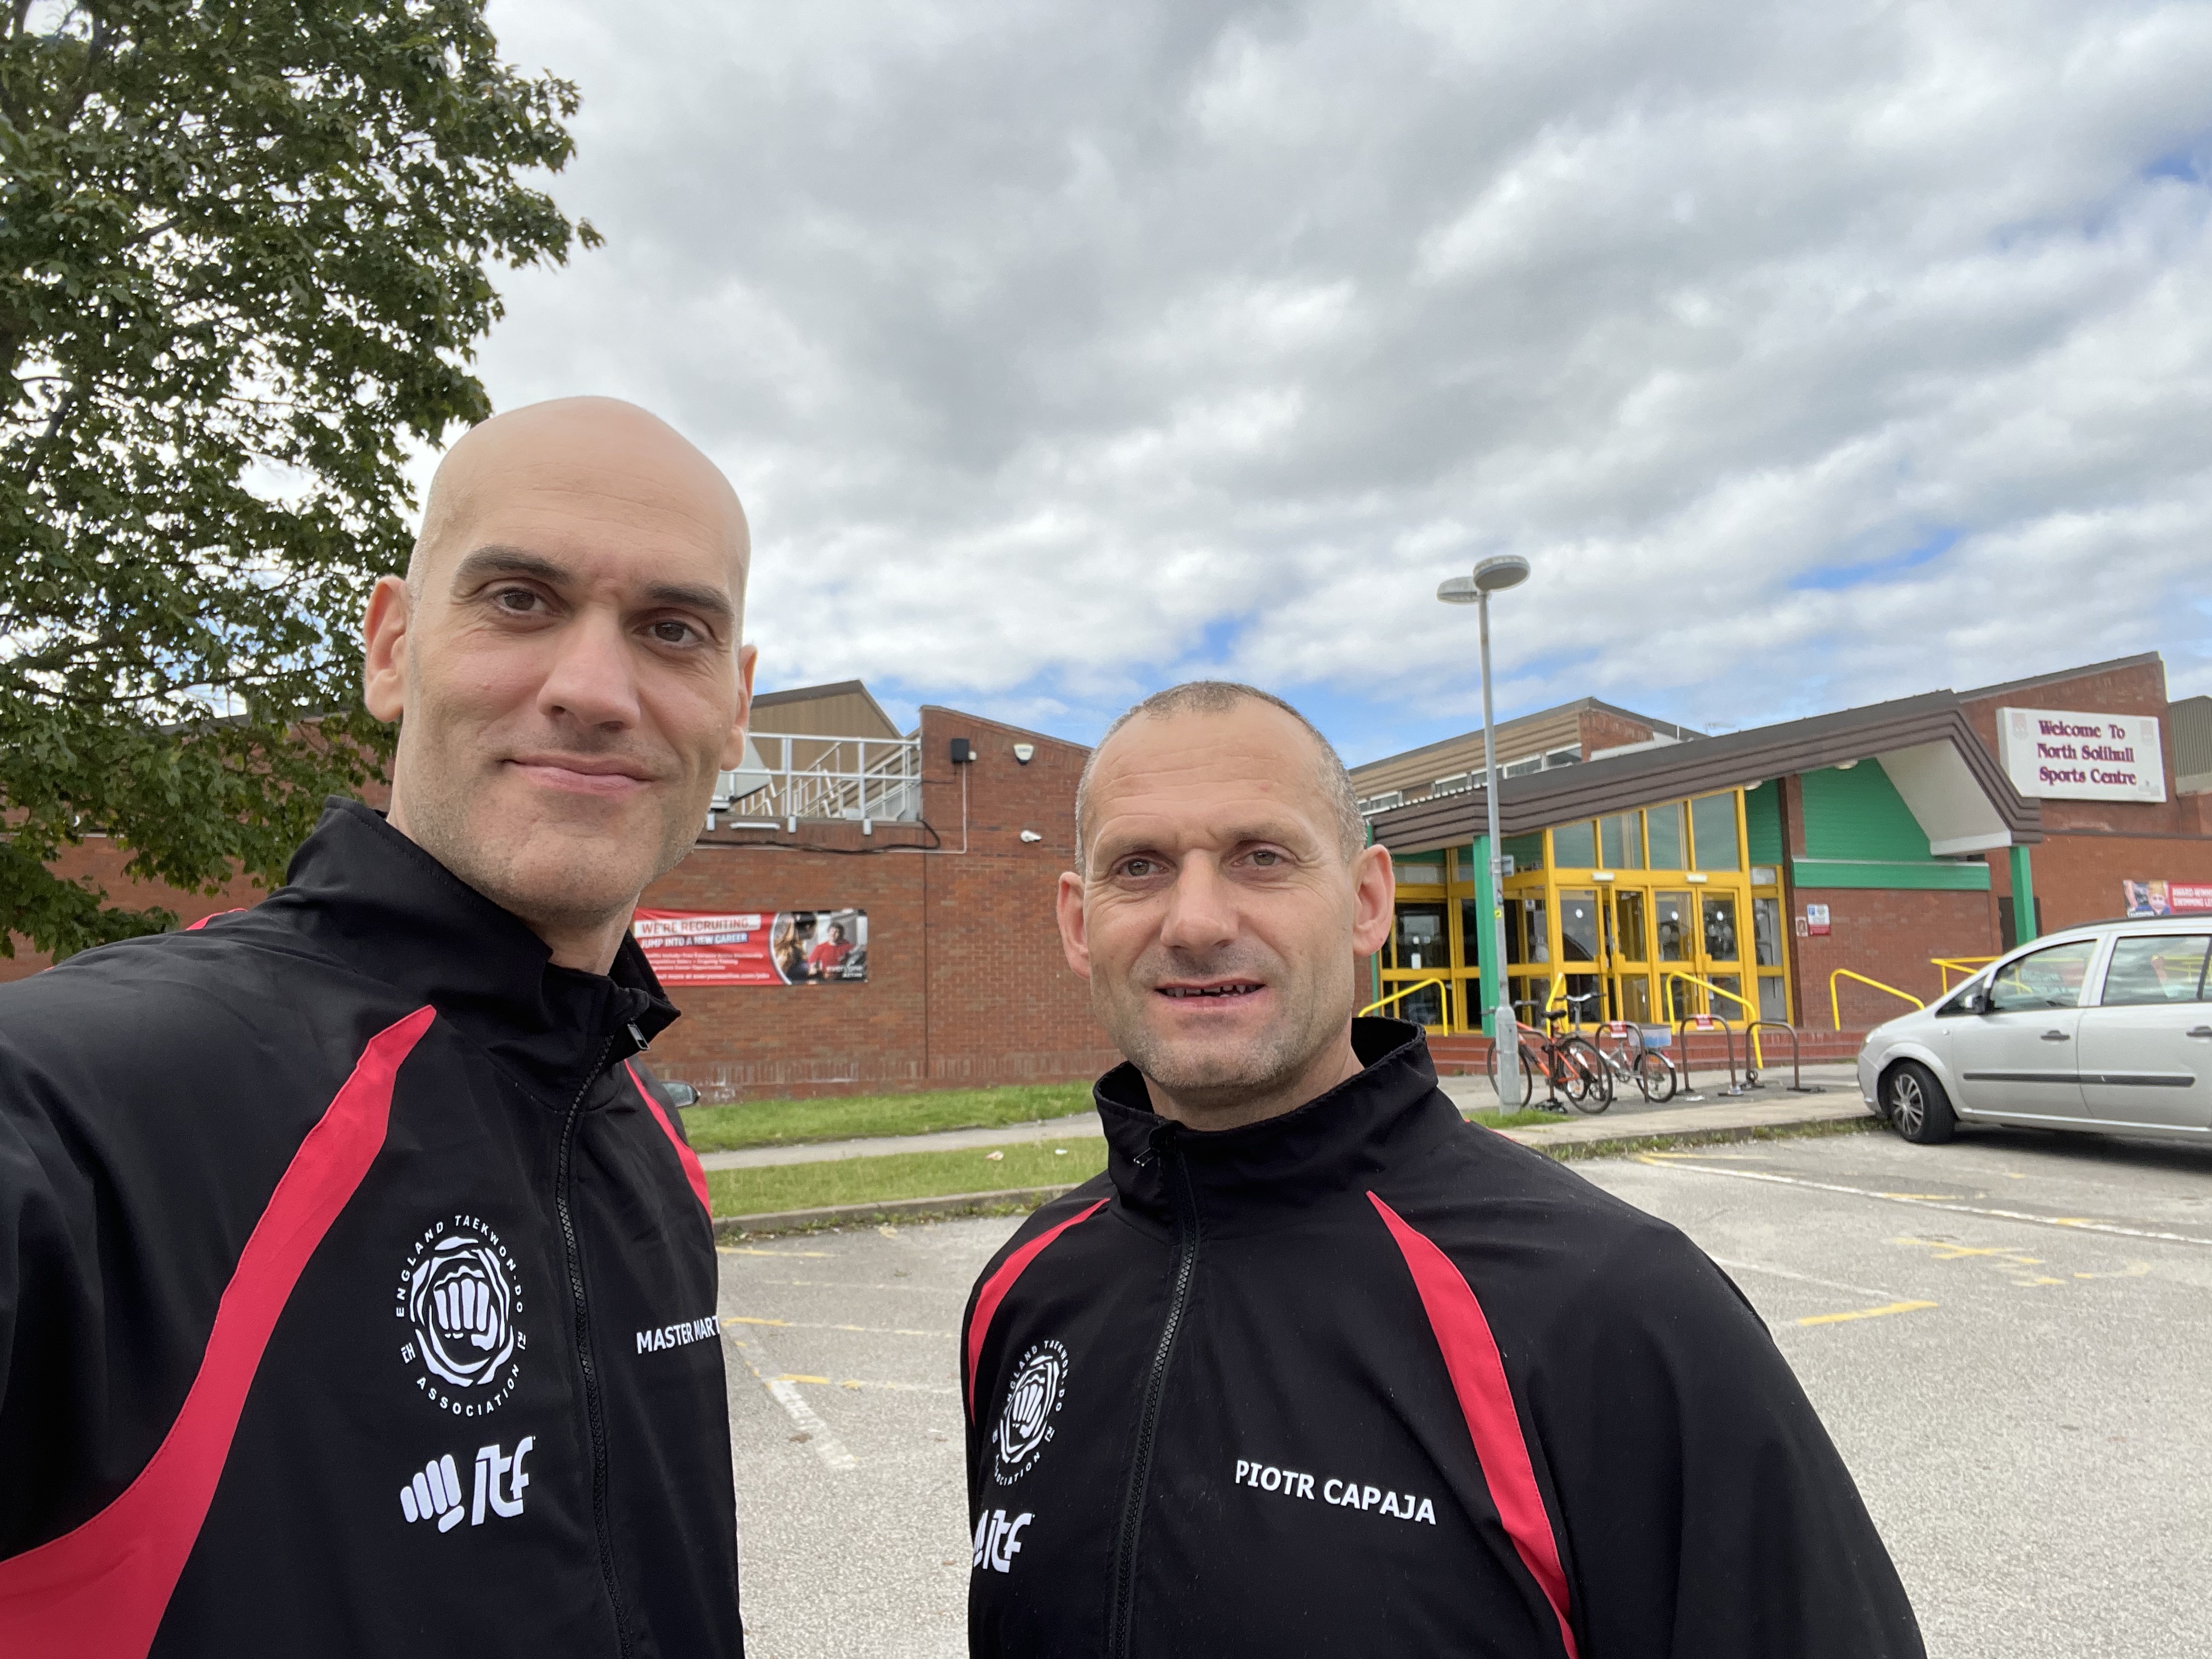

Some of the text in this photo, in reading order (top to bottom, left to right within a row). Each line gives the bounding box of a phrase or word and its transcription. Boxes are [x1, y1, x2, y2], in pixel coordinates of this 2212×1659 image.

[2038, 720, 2125, 740] Welcome To
[2037, 742, 2135, 763] North Solihull
[2039, 766, 2137, 786] Sports Centre
[641, 933, 747, 948] JUMP INTO A NEW CAREER
[642, 922, 676, 934] WE'RE
[396, 1215, 523, 1317] ENGLAND TAEKWON-DO
[636, 1322, 695, 1355] MASTER
[1044, 1340, 1068, 1412] TAEKWON-DO
[416, 1364, 519, 1417] ASSOCIATION
[1235, 1459, 1436, 1526] PIOTR CAPAJA
